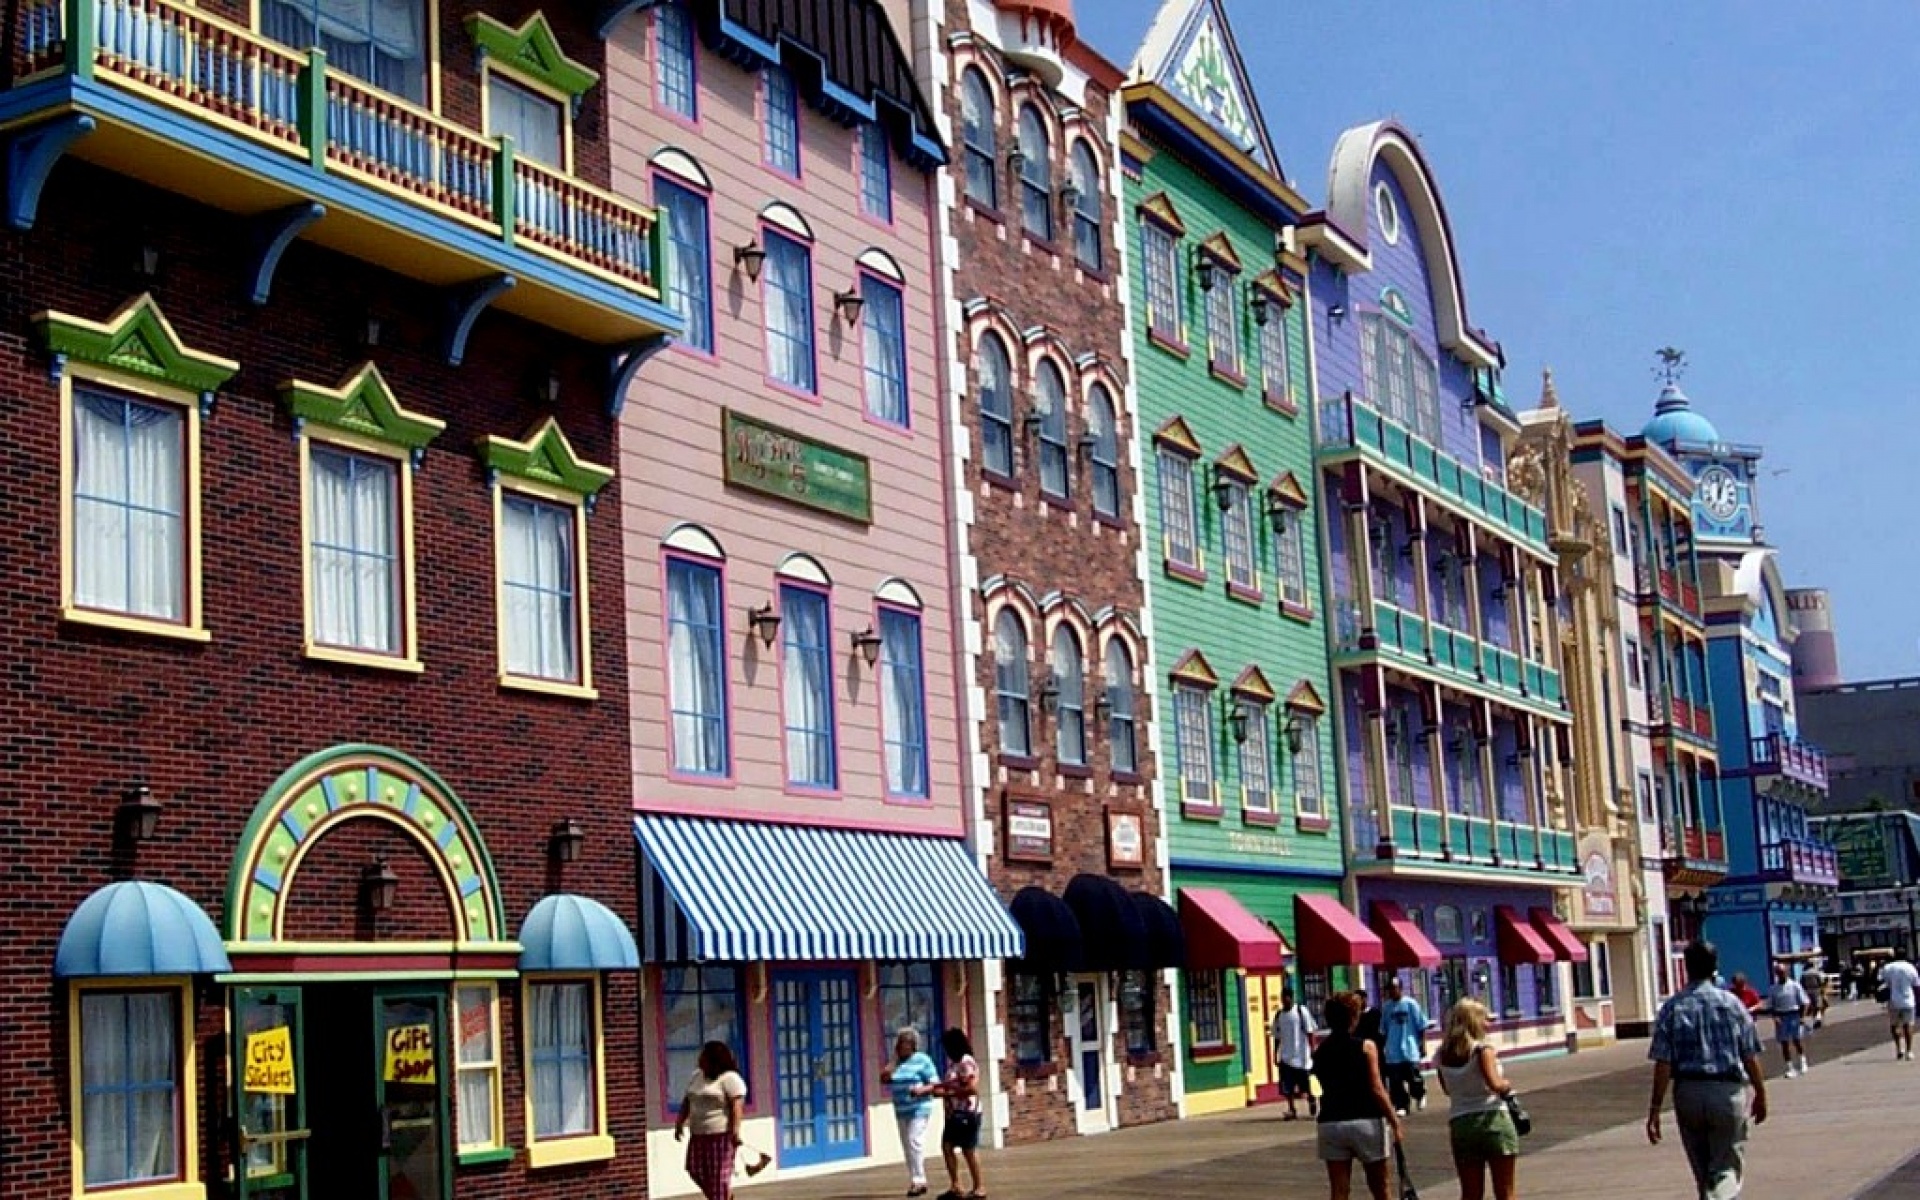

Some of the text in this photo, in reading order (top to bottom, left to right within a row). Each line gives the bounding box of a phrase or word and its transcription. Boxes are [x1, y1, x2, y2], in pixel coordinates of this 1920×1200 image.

[252, 1039, 286, 1063] City
[392, 1027, 432, 1051] Gift
[394, 1057, 434, 1080] Shop
